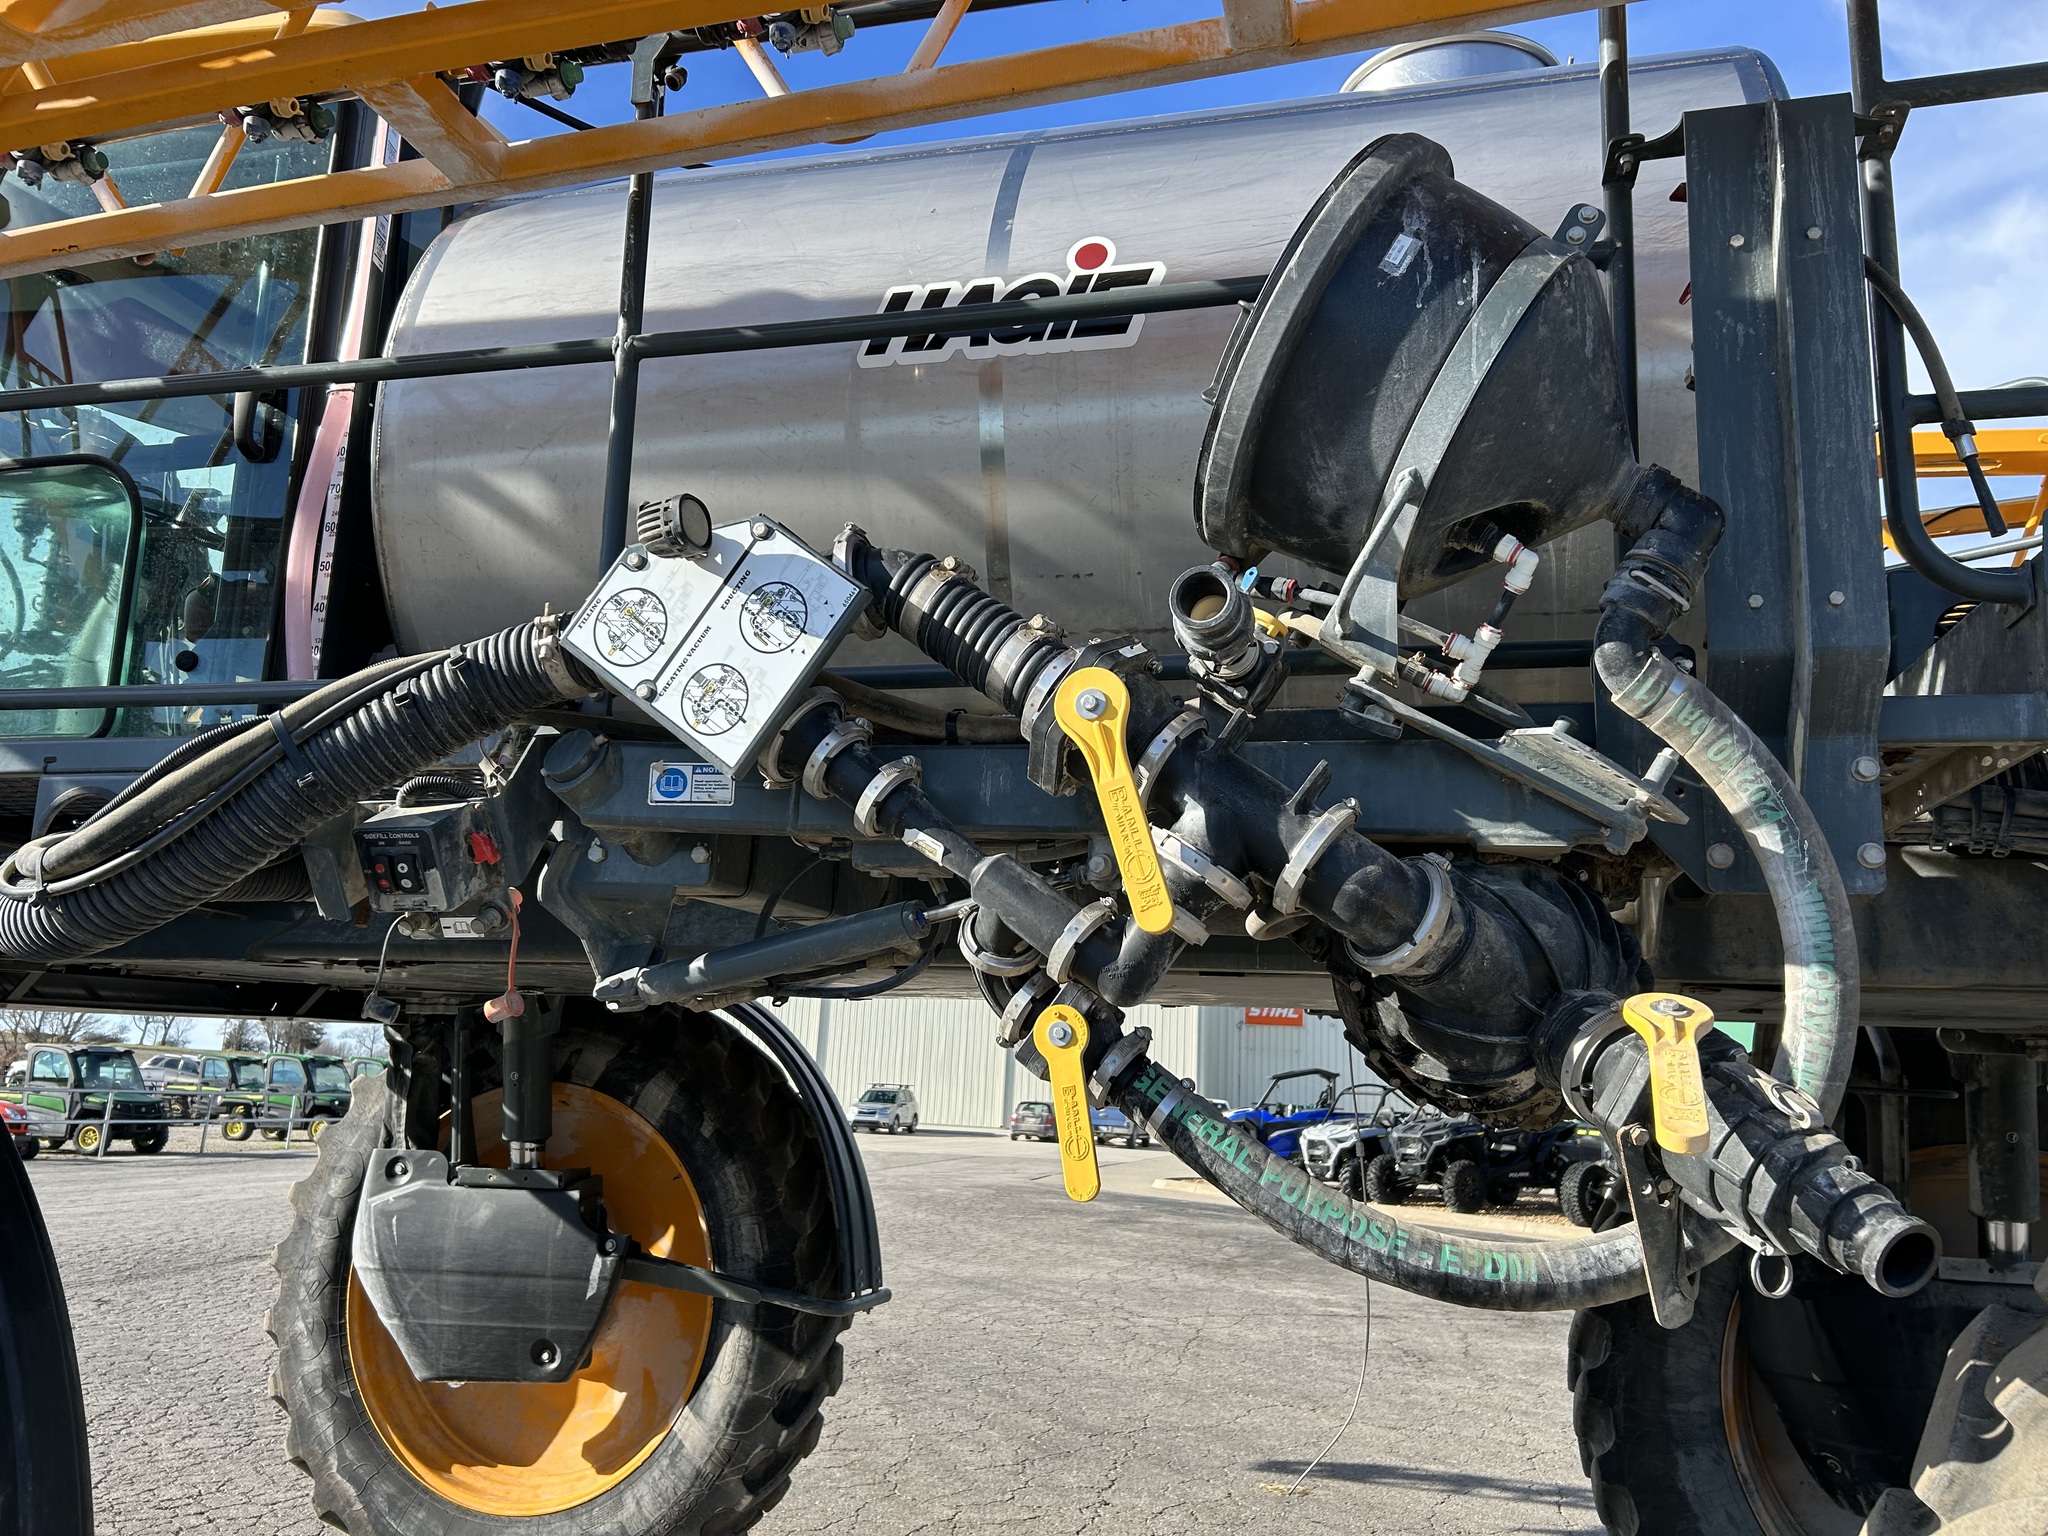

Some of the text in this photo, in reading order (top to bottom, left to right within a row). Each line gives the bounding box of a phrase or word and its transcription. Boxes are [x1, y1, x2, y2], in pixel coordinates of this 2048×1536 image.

[861, 241, 1157, 358] HAGIE
[330, 484, 341, 494] 70
[324, 522, 336, 533] 60
[319, 561, 331, 572] 50
[720, 570, 751, 610] EDUCTING
[313, 602, 325, 613] 40
[578, 598, 601, 629] FILLING
[658, 625, 712, 697] CREATING VACUUM
[1794, 878, 1839, 1094] ALFAGOMMA
[1248, 1006, 1299, 1019] STIHL
[1132, 1066, 1252, 1175] GENERAL
[1259, 1163, 1410, 1260] PURPOSE
[1440, 1243, 1539, 1284] EPDM
